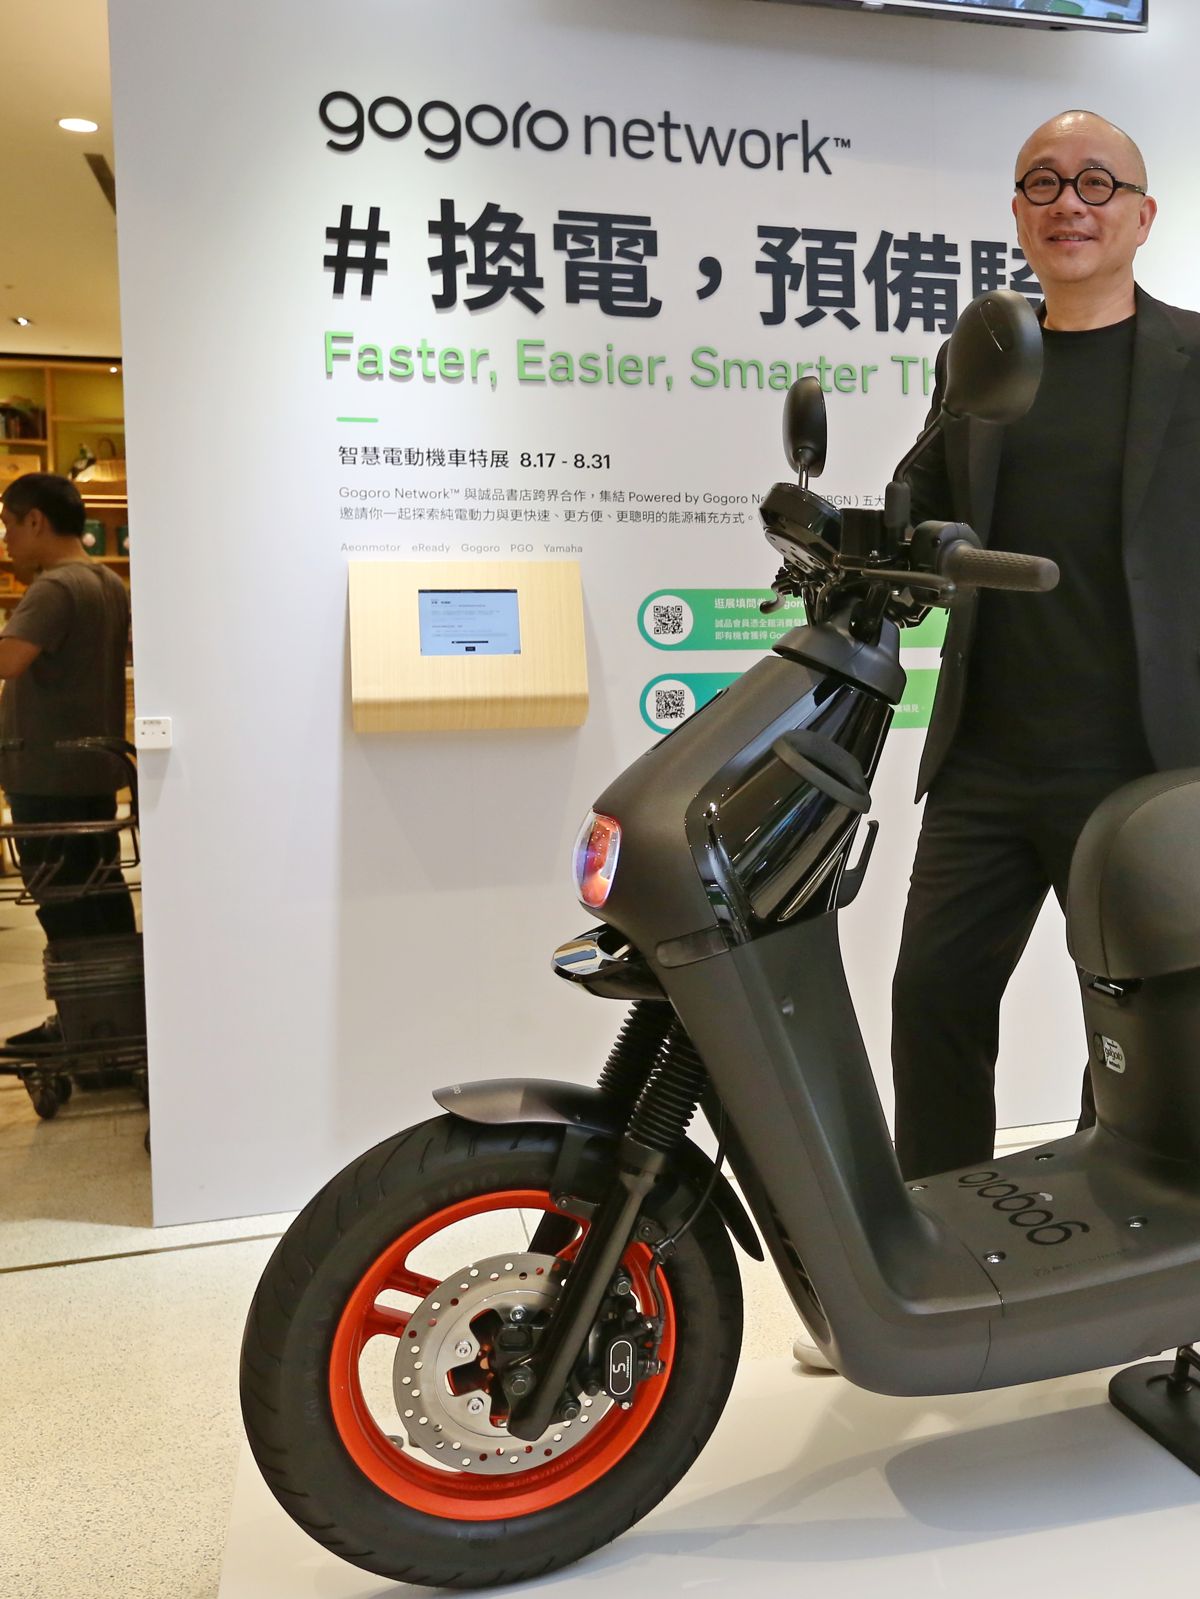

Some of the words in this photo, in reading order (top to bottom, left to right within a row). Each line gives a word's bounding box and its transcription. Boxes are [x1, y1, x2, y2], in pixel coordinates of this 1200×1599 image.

[319, 90, 568, 159] gogoro
[324, 330, 498, 389] Faster,
[516, 339, 673, 391] Easier,
[691, 344, 878, 395] Smarter
[338, 445, 509, 469] 智慧電動機車特展
[519, 452, 556, 468] 8.17
[573, 453, 611, 469] 8.31
[338, 486, 391, 500] Gogoro
[628, 491, 682, 504] Powered
[685, 492, 699, 506] by
[702, 493, 748, 507] Gogoro
[340, 543, 401, 553] Aeonmotor
[411, 543, 451, 554] eReady
[461, 543, 500, 554] Gogoro
[510, 543, 534, 553] PGO
[543, 544, 583, 553] Yamaha
[957, 1171, 1090, 1246] gogoro
